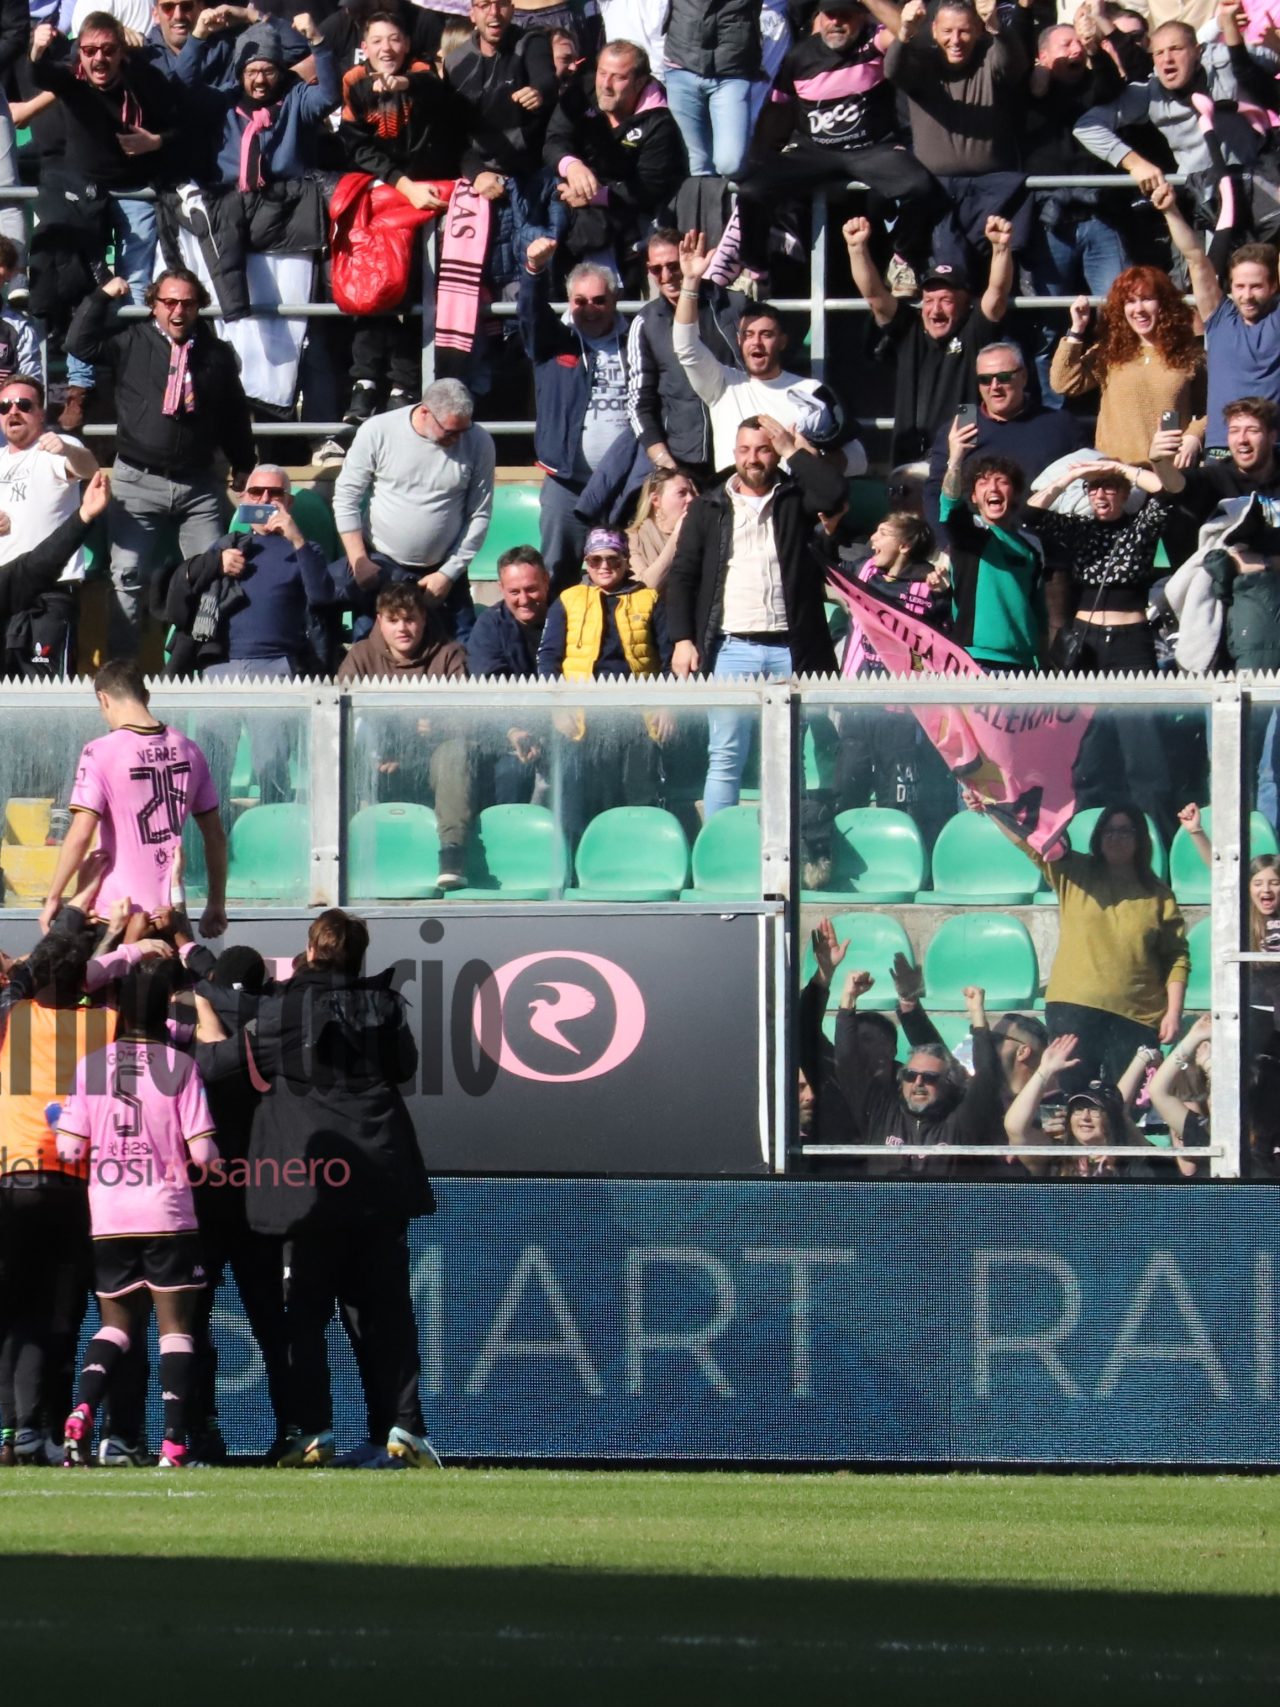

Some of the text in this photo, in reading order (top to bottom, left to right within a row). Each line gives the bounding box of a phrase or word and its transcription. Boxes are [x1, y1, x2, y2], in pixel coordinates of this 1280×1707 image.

[136, 746, 178, 764] VERRE
[128, 761, 192, 845] 26
[112, 1064, 143, 1137] 5
